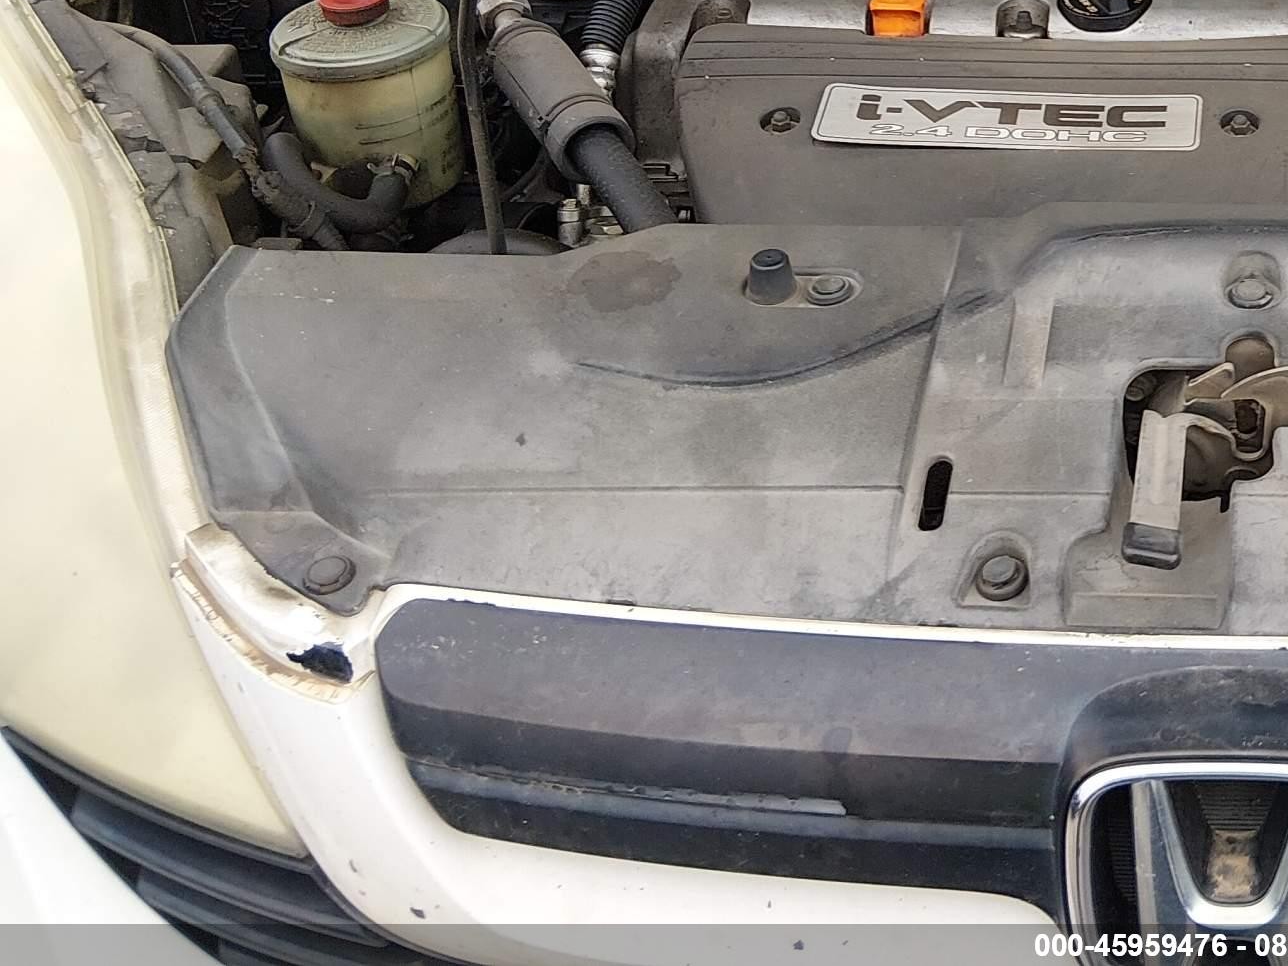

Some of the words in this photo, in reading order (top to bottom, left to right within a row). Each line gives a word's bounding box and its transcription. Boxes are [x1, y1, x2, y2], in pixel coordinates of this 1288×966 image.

[855, 93, 1168, 128] i-VTEC
[869, 122, 953, 139] 2.4
[965, 125, 1148, 143] DOHC
